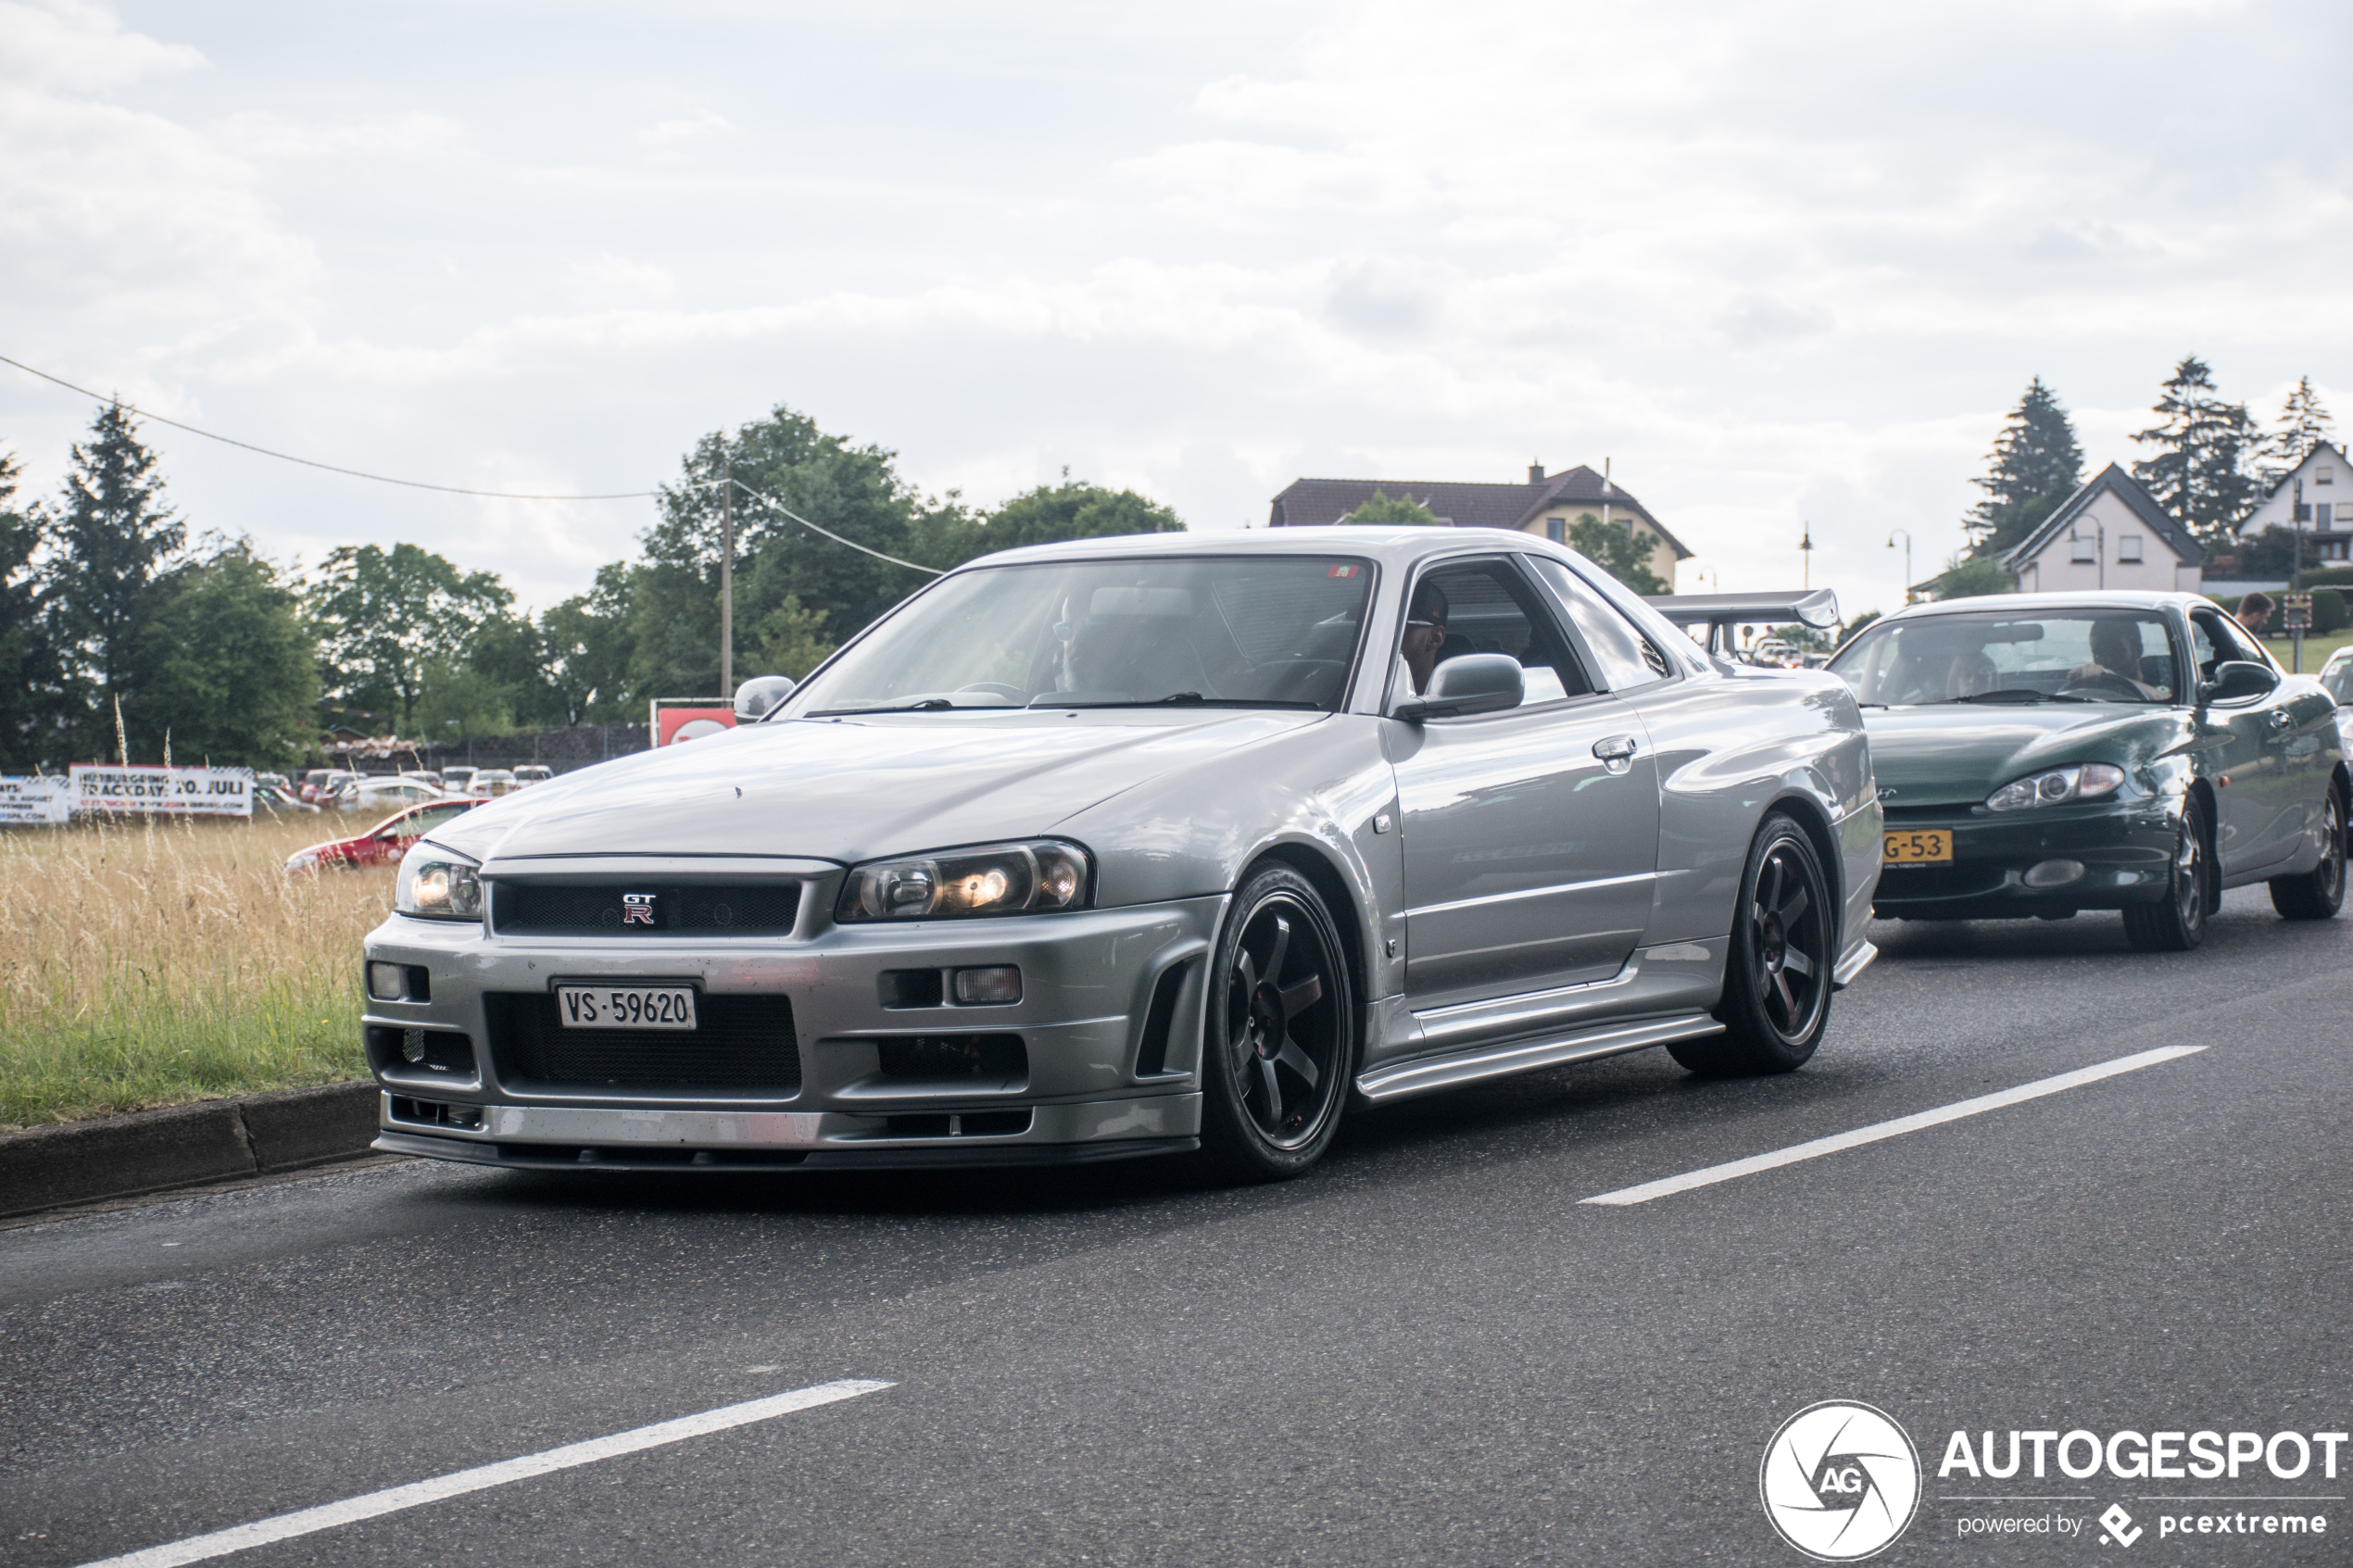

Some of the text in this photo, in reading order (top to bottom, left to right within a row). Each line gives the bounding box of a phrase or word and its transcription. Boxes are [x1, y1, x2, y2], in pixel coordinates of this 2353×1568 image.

[175, 780, 244, 795] 20. JULI
[1883, 834, 1942, 858] G-53
[623, 894, 657, 904] GT
[623, 904, 655, 924] R
